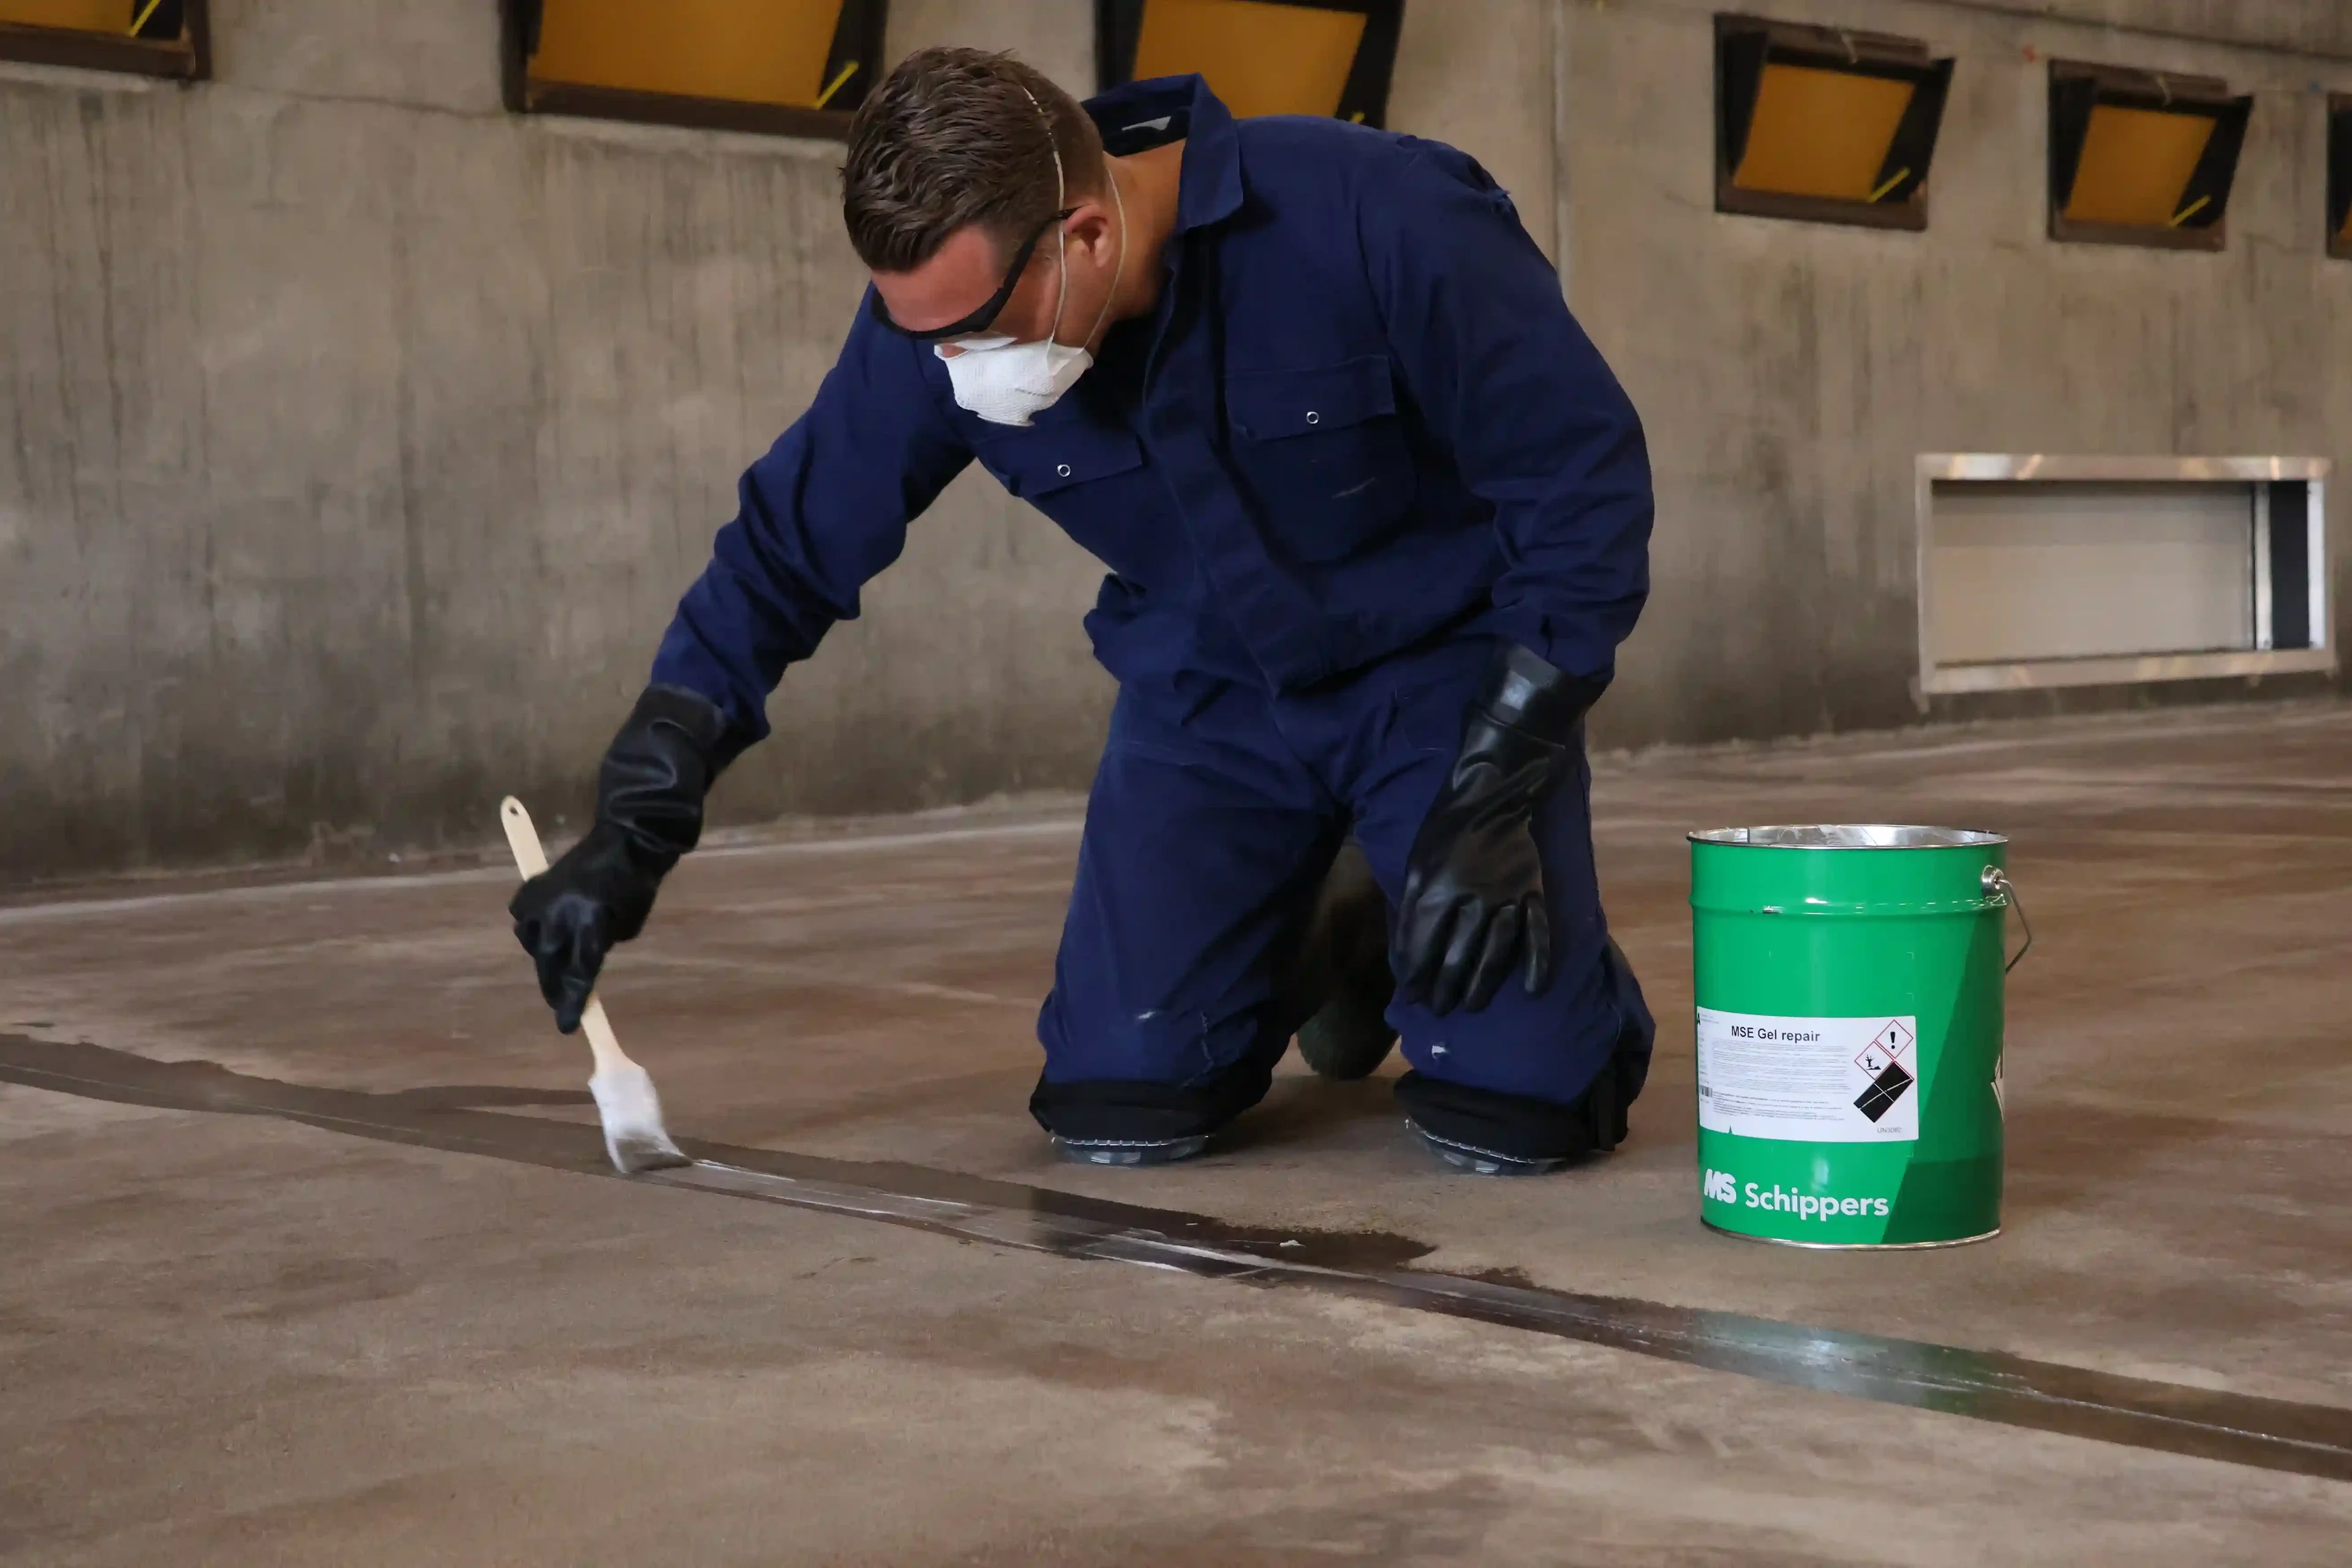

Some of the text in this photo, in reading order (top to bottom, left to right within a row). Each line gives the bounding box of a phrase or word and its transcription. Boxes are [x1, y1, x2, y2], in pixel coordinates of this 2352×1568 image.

[1732, 1025, 1820, 1044] MSE Gel repair
[1703, 1169, 1890, 1222] MS Schippers
